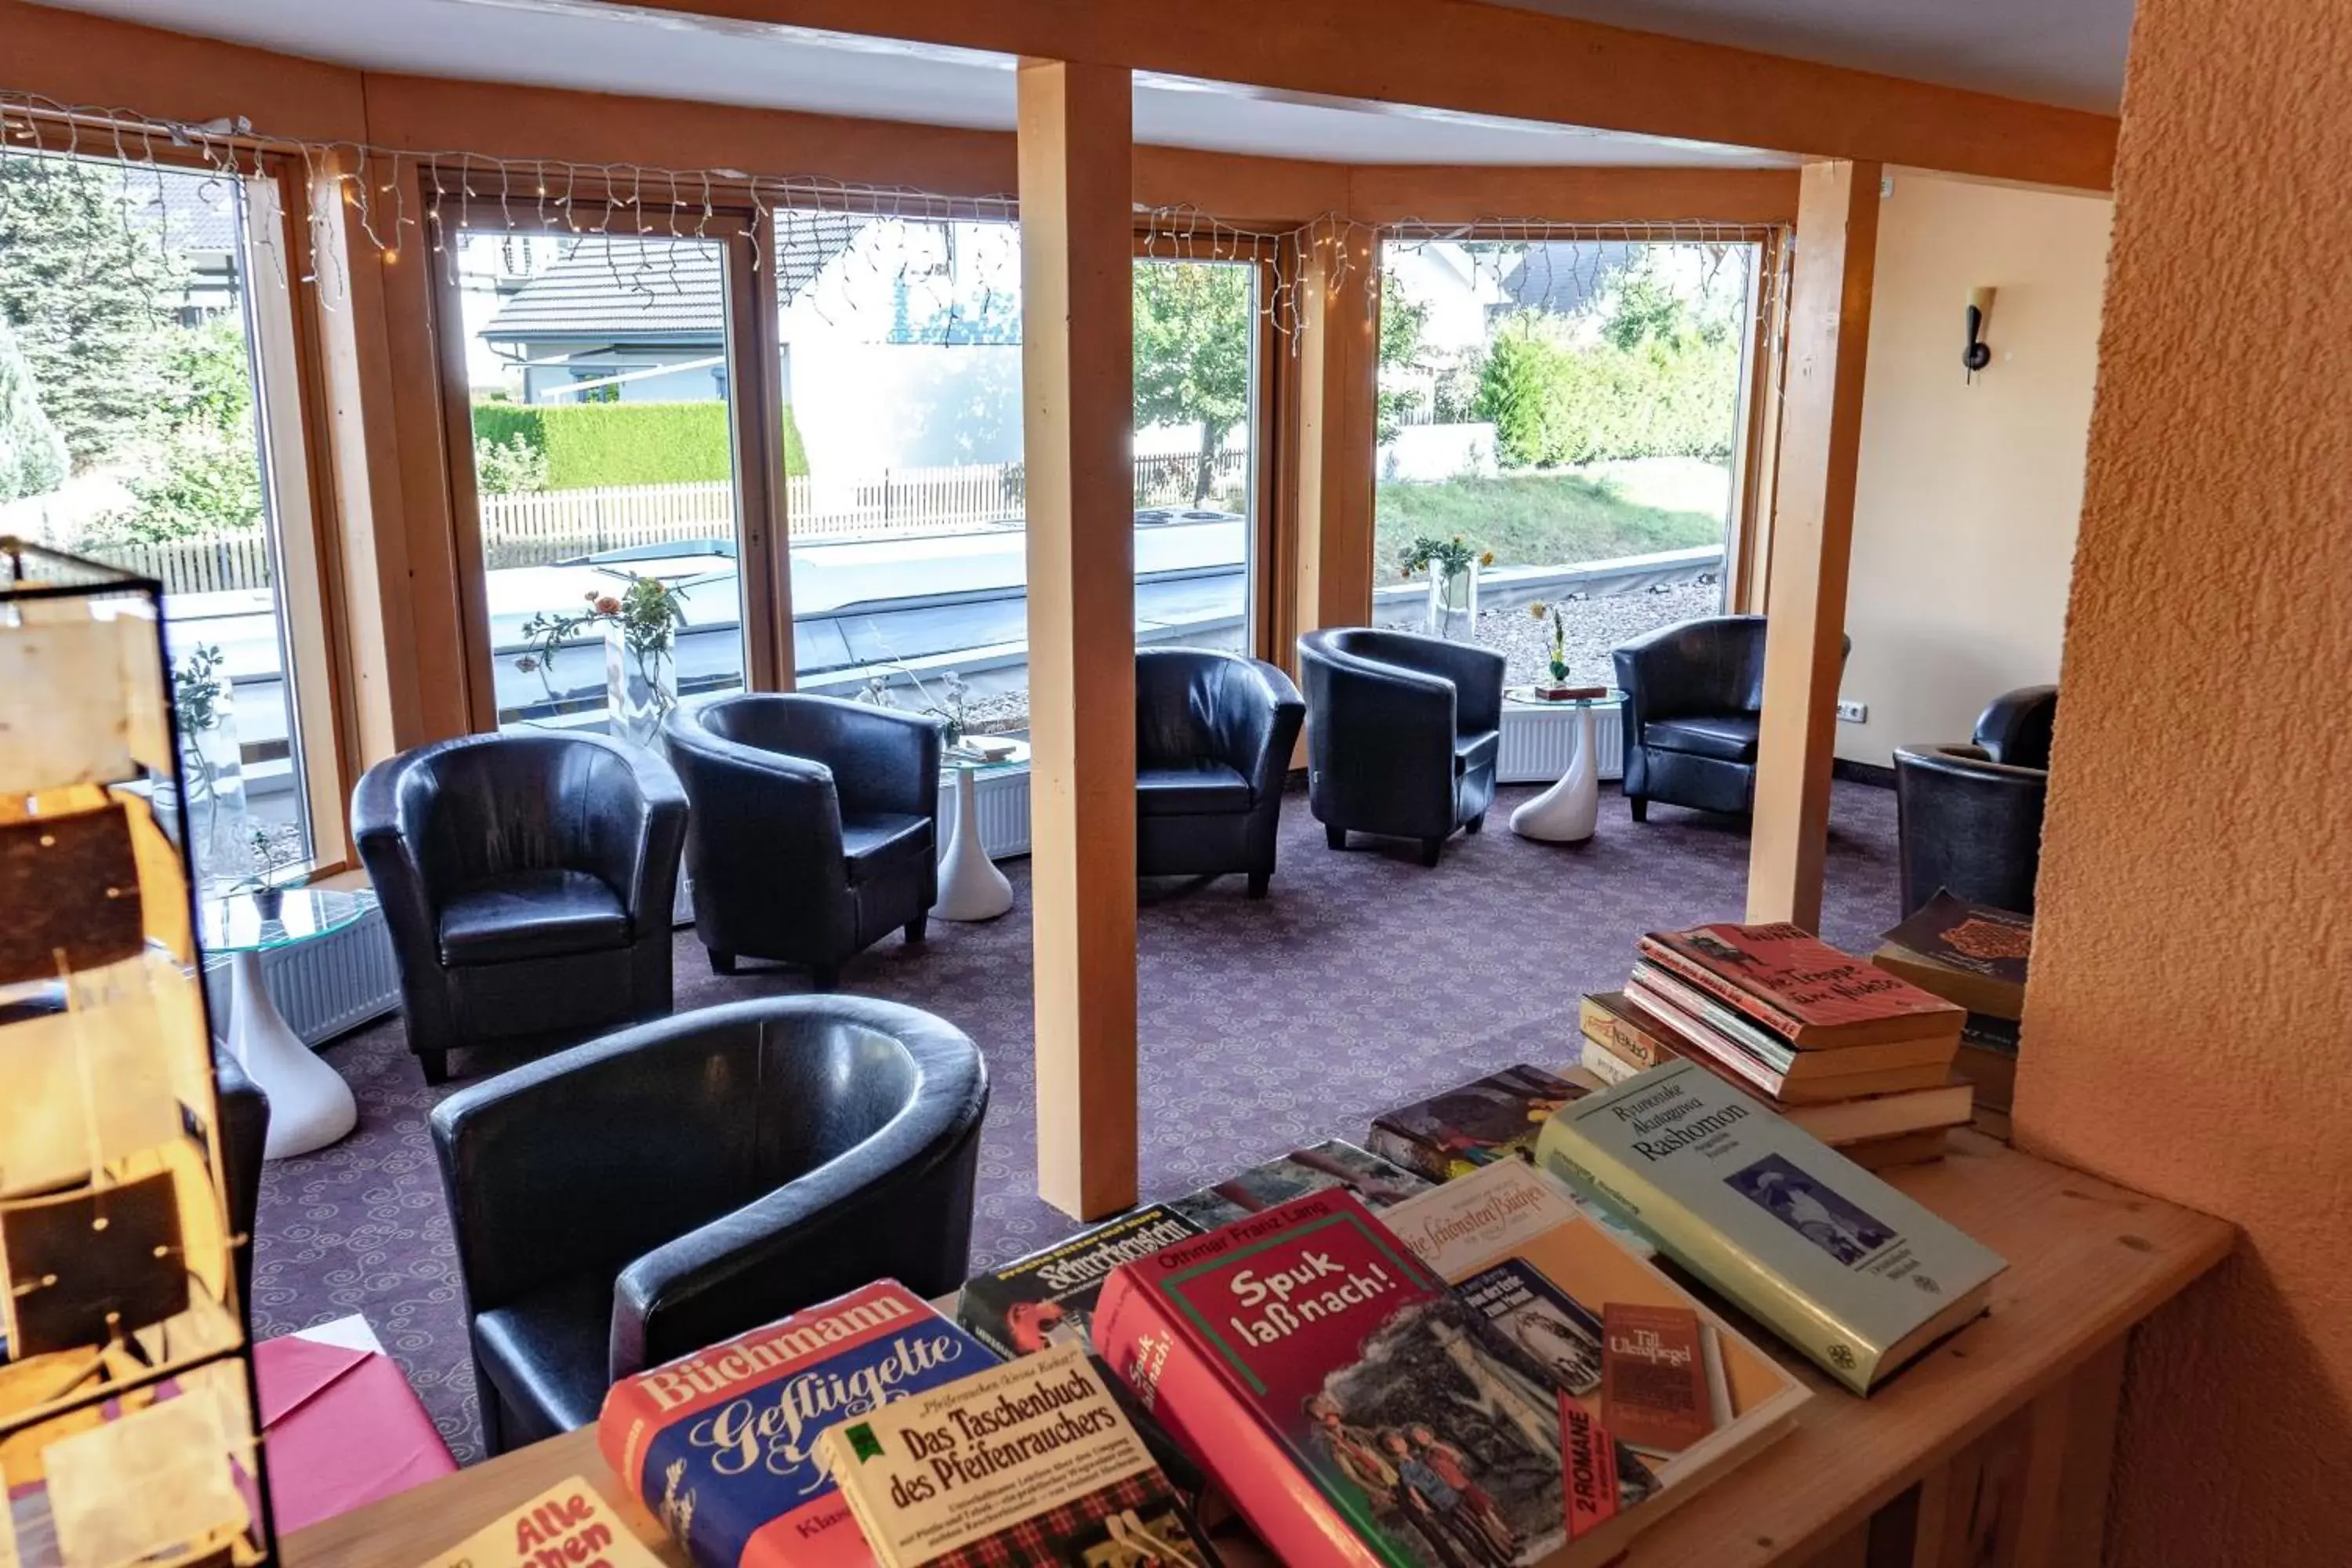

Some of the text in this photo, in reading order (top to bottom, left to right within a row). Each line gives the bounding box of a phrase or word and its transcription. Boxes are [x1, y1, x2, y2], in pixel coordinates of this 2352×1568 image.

[1631, 1103, 1750, 1162] Rashomon
[1157, 1200, 1332, 1269] Othmar Franz Lang
[1230, 1250, 1345, 1307] Spuk
[1230, 1301, 1300, 1347] laß
[1298, 1261, 1397, 1323] nach!
[636, 1294, 914, 1413] Büchmann
[1129, 1333, 1155, 1388] Spuk
[1610, 1335, 1692, 1366] Ulenspiegel
[1633, 1328, 1663, 1347] Till
[689, 1334, 963, 1475] Geflügelte
[898, 1423, 956, 1461] Das
[948, 1370, 1097, 1443] Taschenbuch
[890, 1473, 936, 1510] des
[931, 1406, 1117, 1492] Pfeifenrauchers
[516, 1494, 594, 1555] Alle
